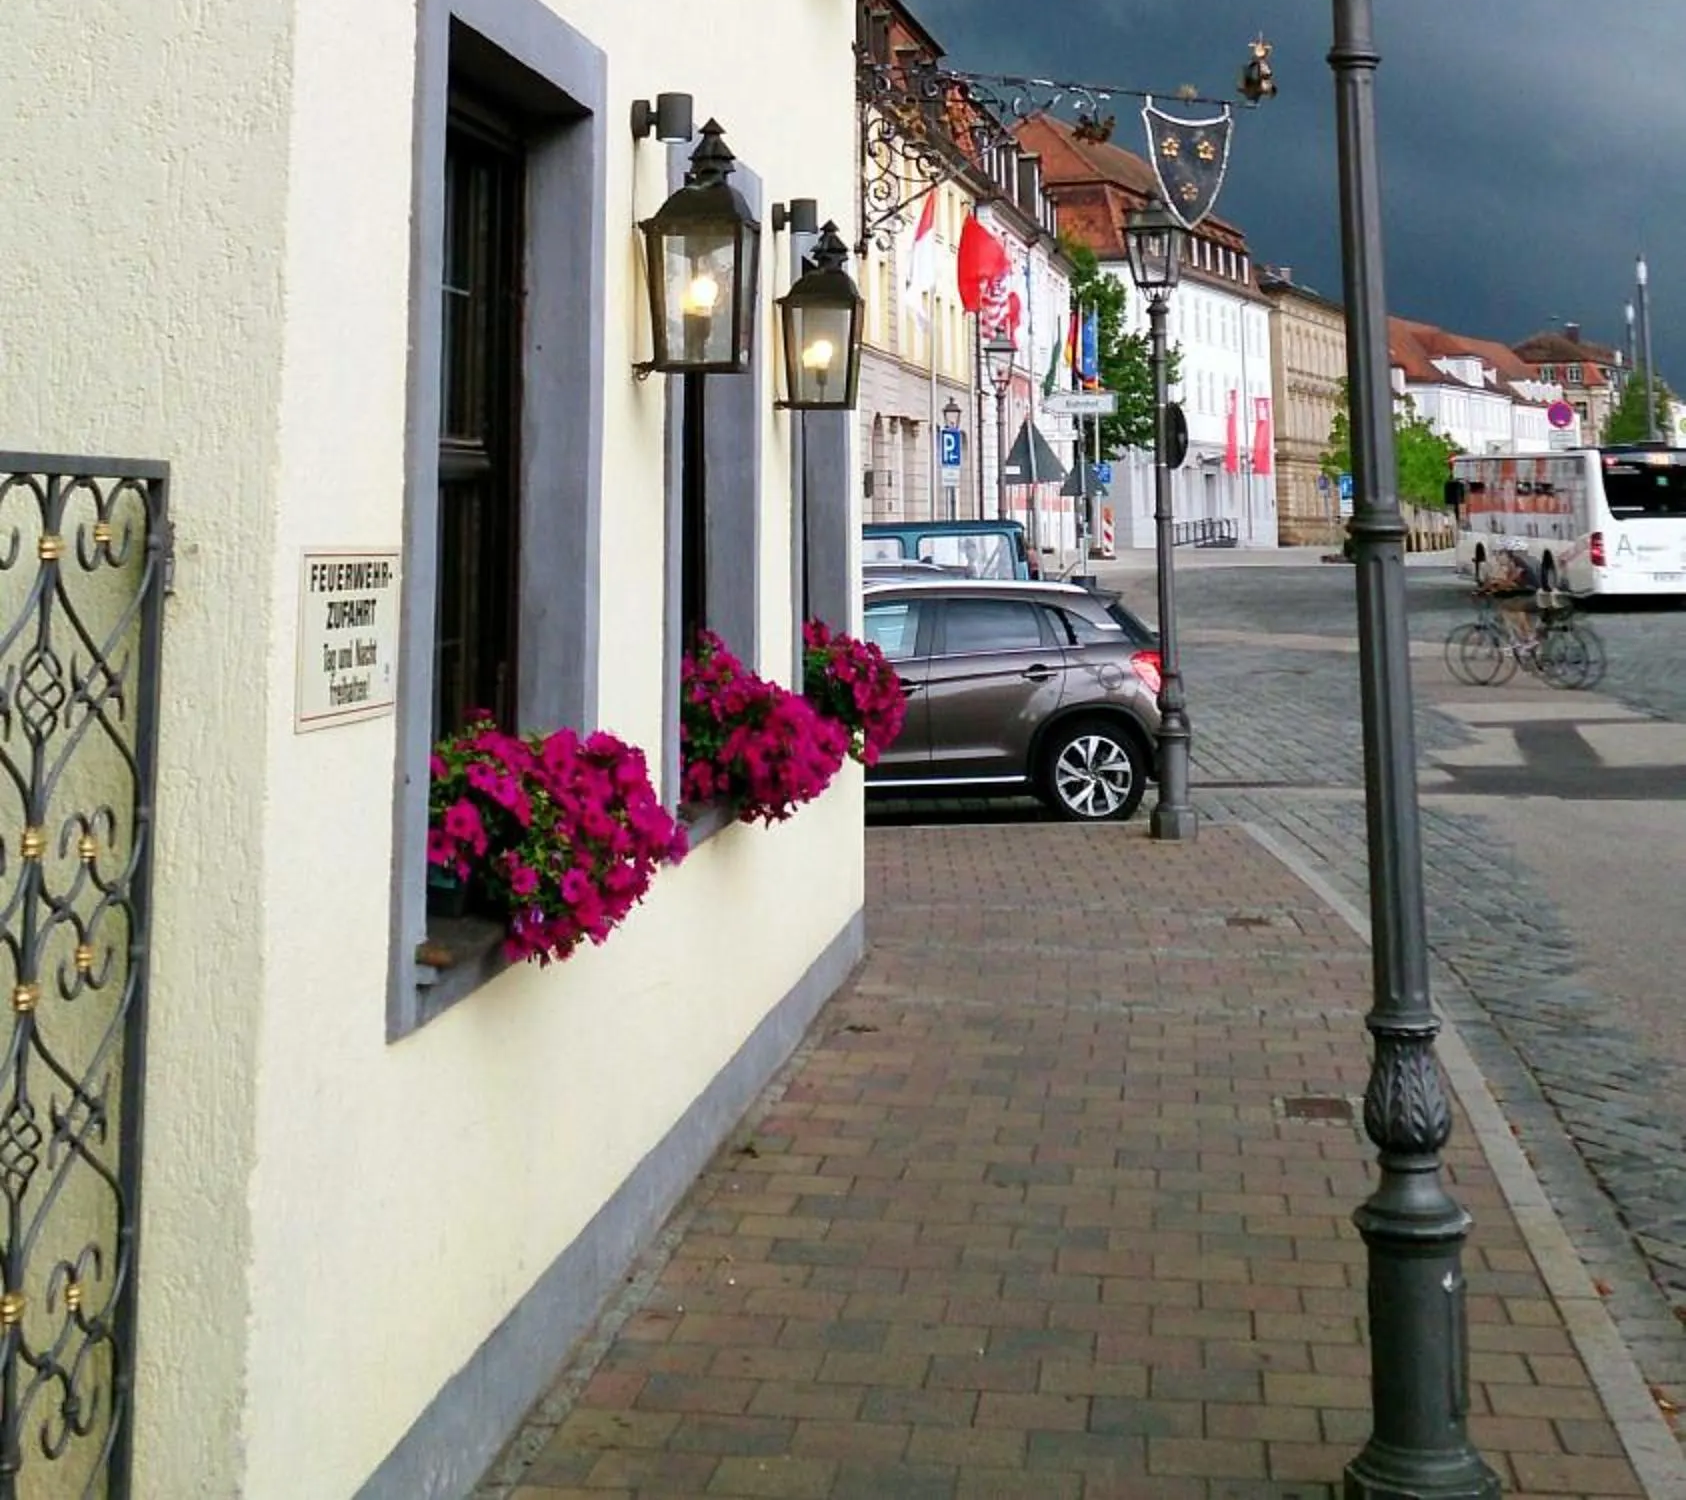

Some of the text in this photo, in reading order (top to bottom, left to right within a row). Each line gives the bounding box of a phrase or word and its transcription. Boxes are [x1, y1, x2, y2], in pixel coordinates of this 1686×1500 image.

[943, 433, 955, 462] P
[310, 562, 393, 592] FEUERWEHR-
[326, 599, 376, 630] ZUFAHRT
[323, 637, 377, 673] Tag und Nacht
